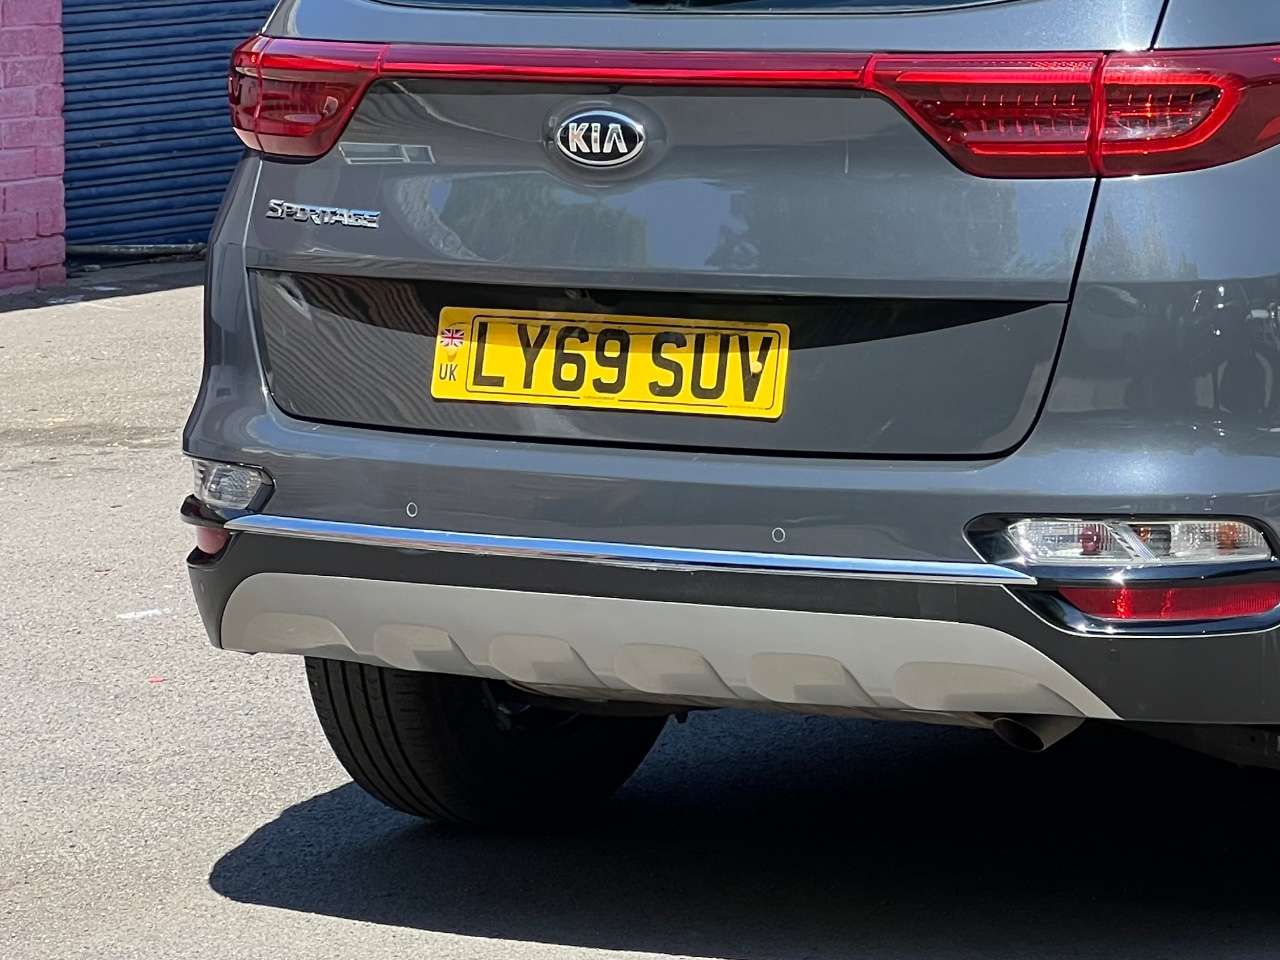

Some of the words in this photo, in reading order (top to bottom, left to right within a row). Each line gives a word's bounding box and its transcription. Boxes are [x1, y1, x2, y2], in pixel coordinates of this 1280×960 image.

[568, 122, 628, 153] KIA
[265, 199, 381, 228] SPORTAGE
[439, 363, 457, 382] UK
[472, 321, 631, 394] LY69
[648, 331, 773, 403] SUV
